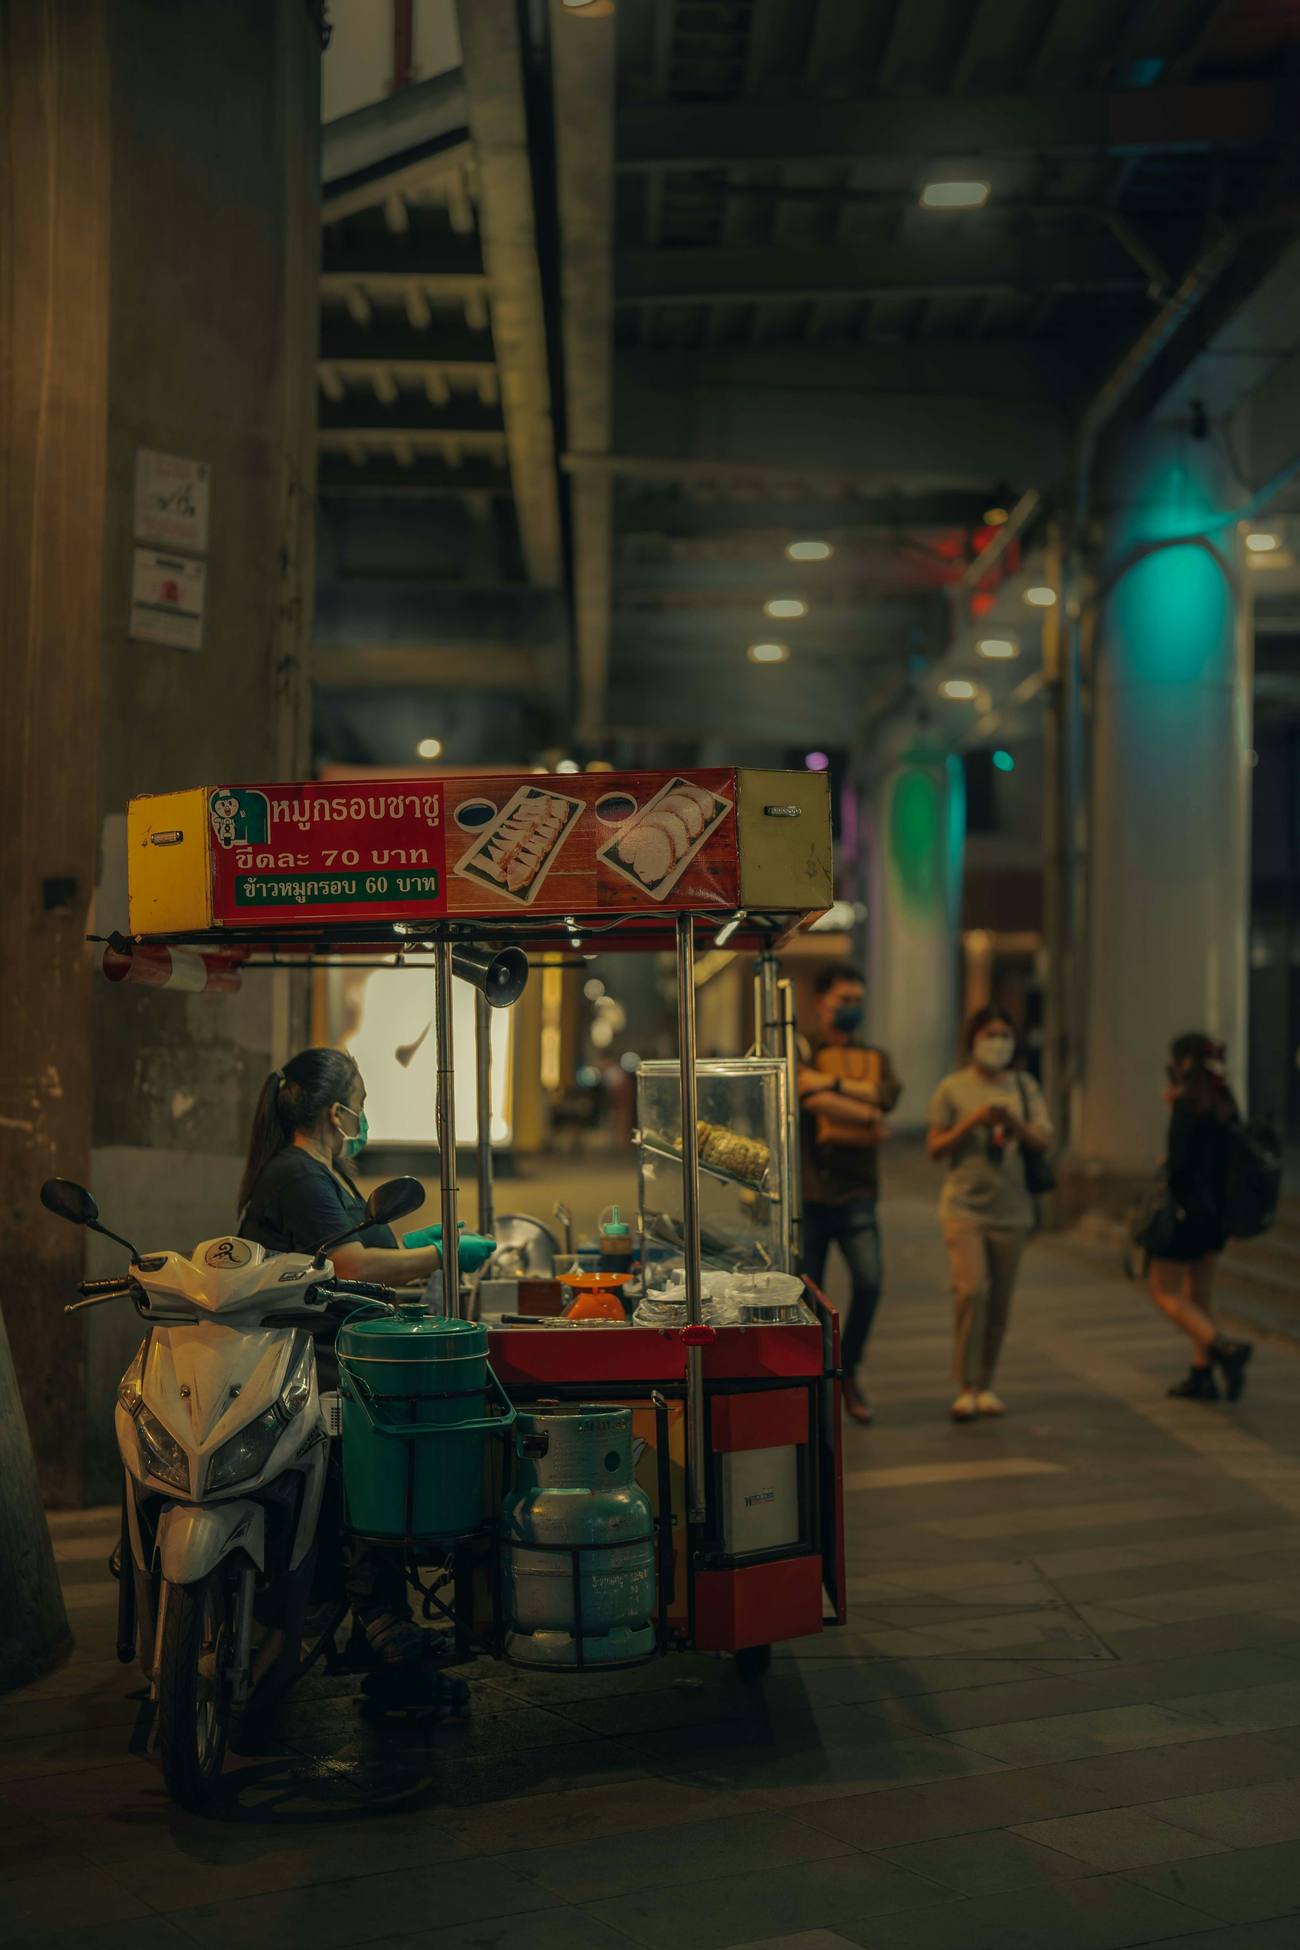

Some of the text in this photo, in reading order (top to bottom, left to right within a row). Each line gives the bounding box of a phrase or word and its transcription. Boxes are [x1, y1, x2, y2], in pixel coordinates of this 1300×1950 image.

[272, 794, 440, 831] หมูกรอบชาชู
[235, 847, 429, 869] ขีดละ 70 บาท
[243, 876, 436, 904] ข้าวหมูกรอบ 60 บาท
